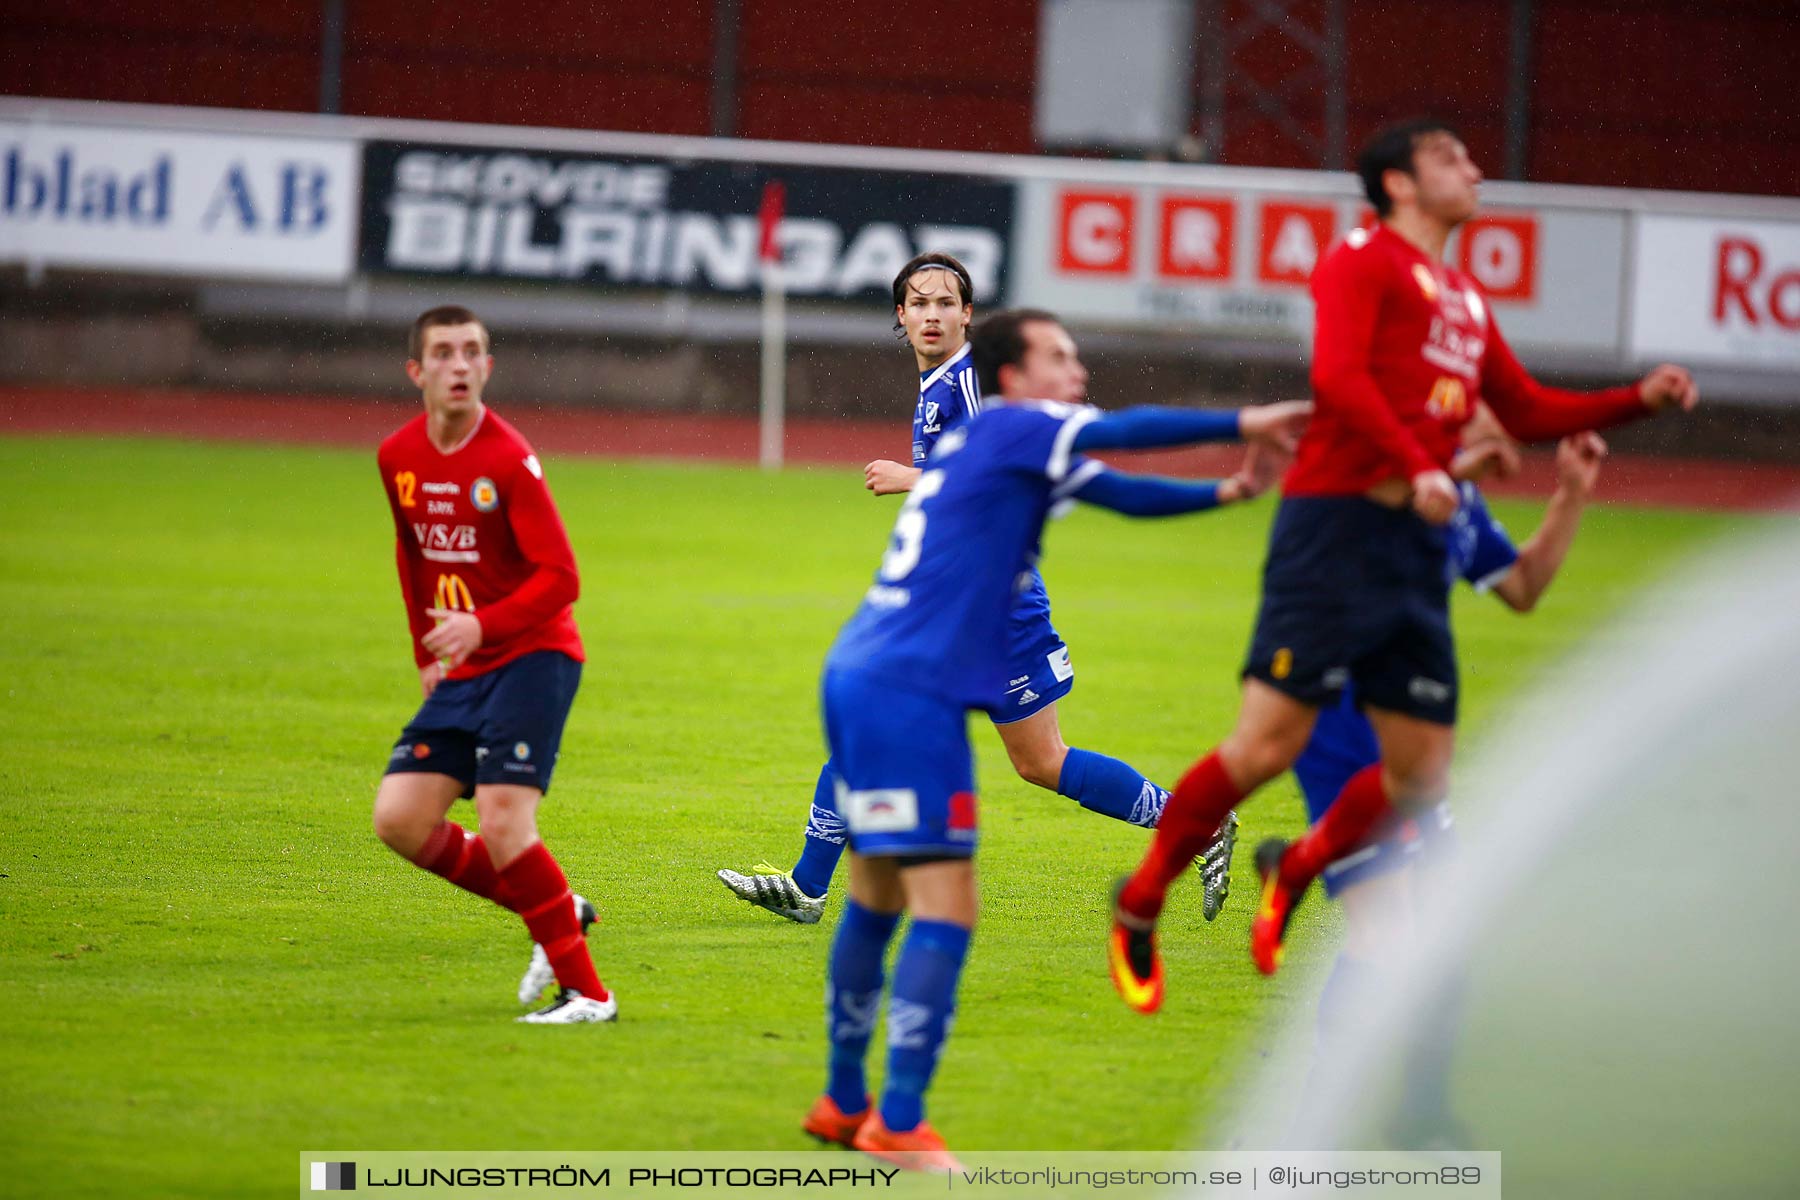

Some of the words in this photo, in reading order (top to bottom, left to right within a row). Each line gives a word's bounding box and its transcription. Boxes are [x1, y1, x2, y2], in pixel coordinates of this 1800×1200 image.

[3, 145, 172, 222] blad
[200, 161, 331, 233] AB
[389, 203, 999, 298] BILRINGAR
[1067, 200, 1524, 290] CRAO
[395, 471, 416, 508] 12
